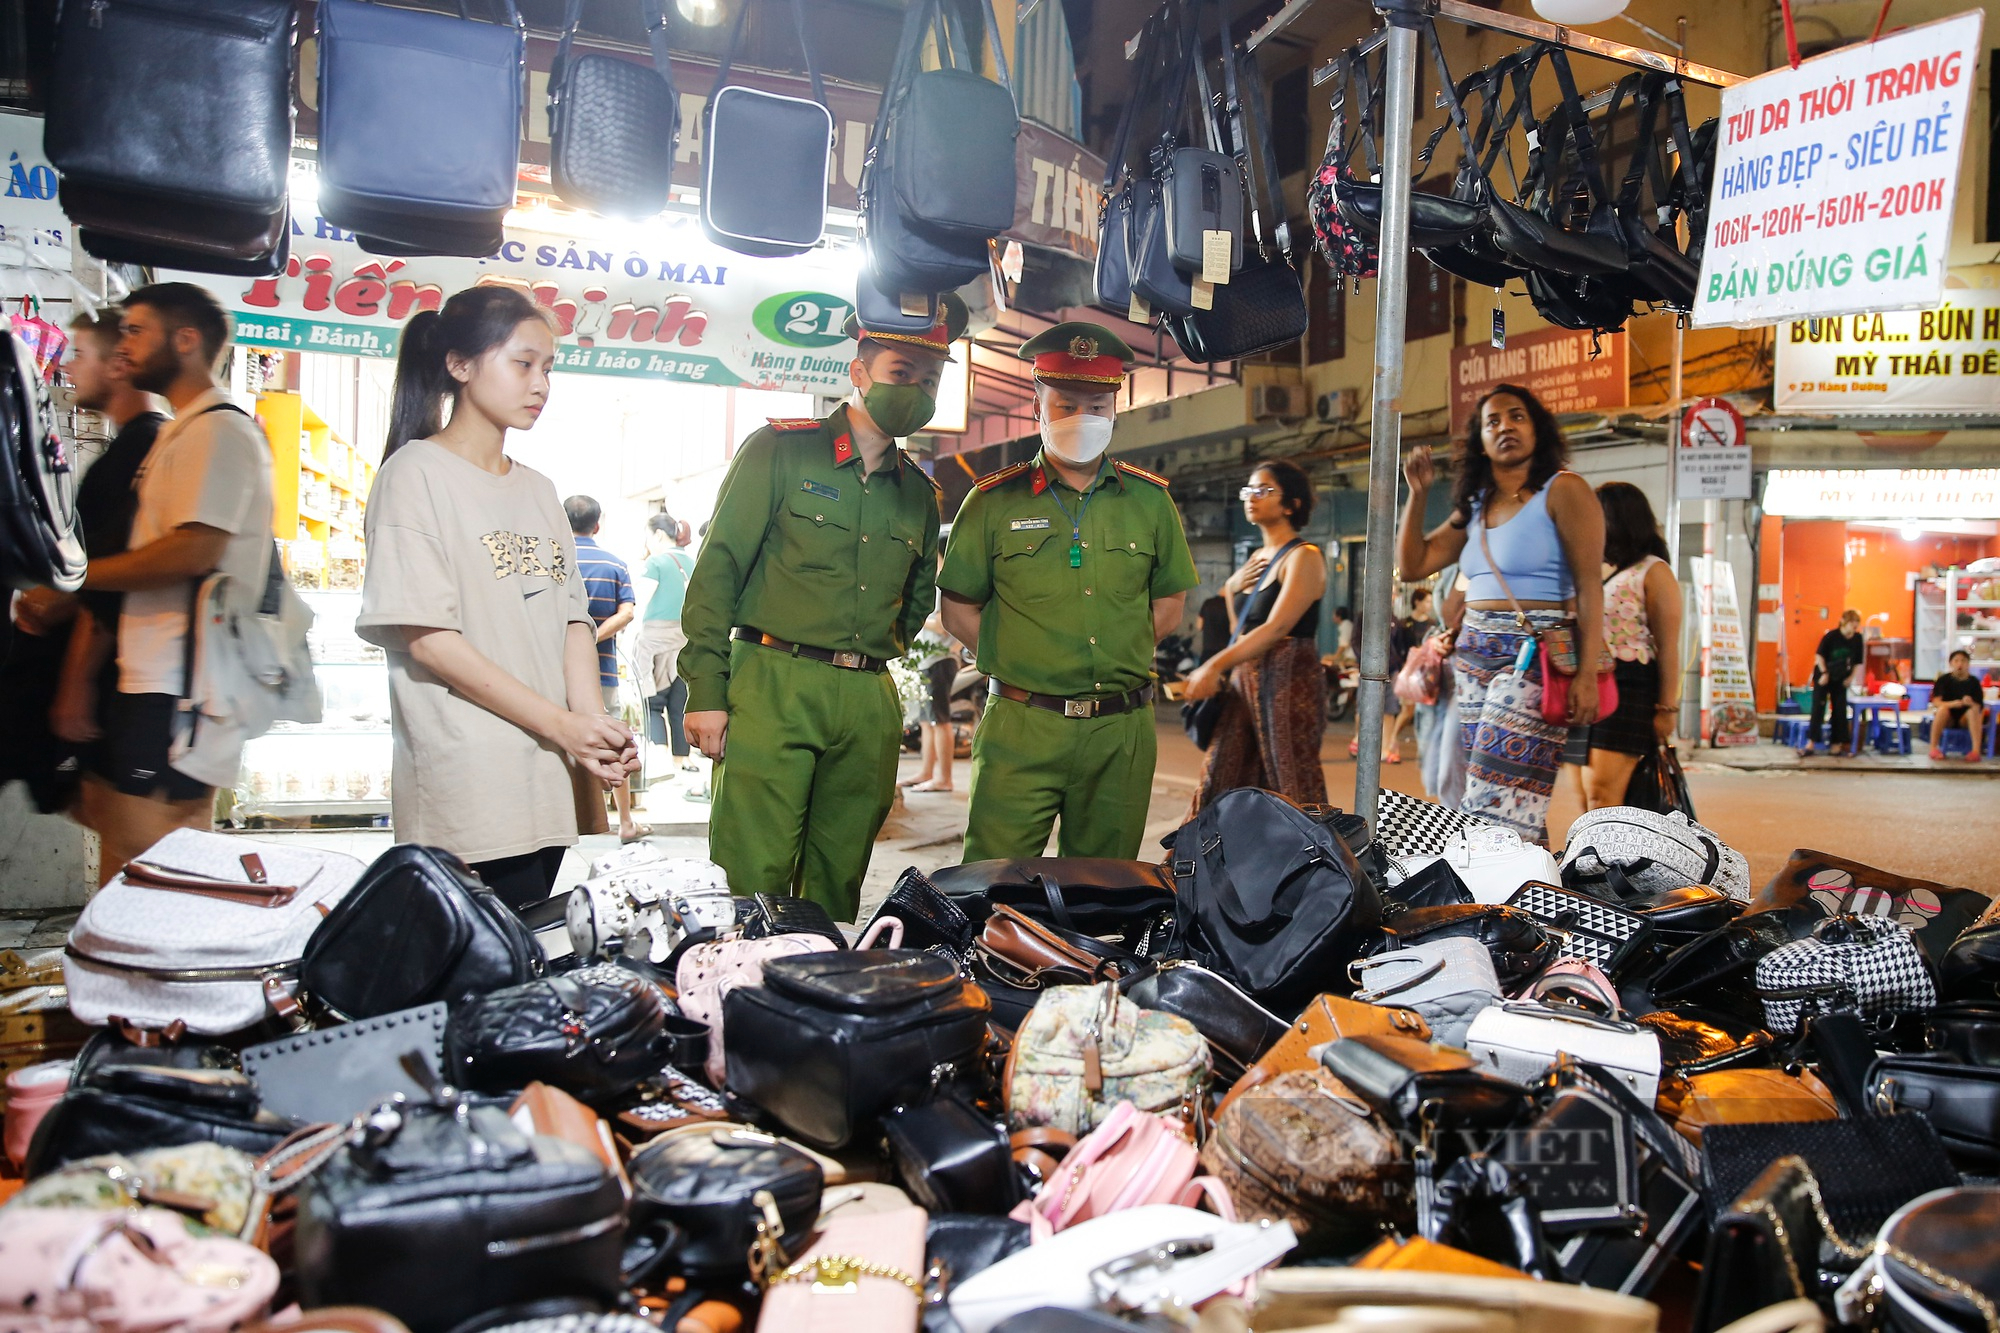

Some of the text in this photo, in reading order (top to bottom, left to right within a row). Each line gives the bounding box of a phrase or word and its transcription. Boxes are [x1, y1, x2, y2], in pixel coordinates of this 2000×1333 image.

[1727, 50, 1963, 146] TÚI DA THỜI TRANG
[1721, 155, 1772, 200] HÀNG
[1778, 142, 1823, 189] ĐẸP
[1845, 120, 1905, 171] SIÊU
[1911, 100, 1952, 157] RẺ
[4, 151, 58, 200] ÁO
[1031, 152, 1099, 243] TIẾN
[535, 239, 613, 273] SẢN
[624, 250, 649, 278] Ô
[656, 260, 728, 286] MAI
[1706, 231, 1929, 303] BÁN ĐÚNG GIÁ
[784, 301, 849, 337] 21
[1919, 302, 1974, 341] BÚN
[595, 350, 642, 370] hảo
[641, 353, 709, 380] hạng
[751, 351, 796, 371] Hàng
[1459, 347, 1487, 386] CỬA
[1529, 336, 1579, 372] TRANG
[1889, 350, 1951, 376] THÁI
